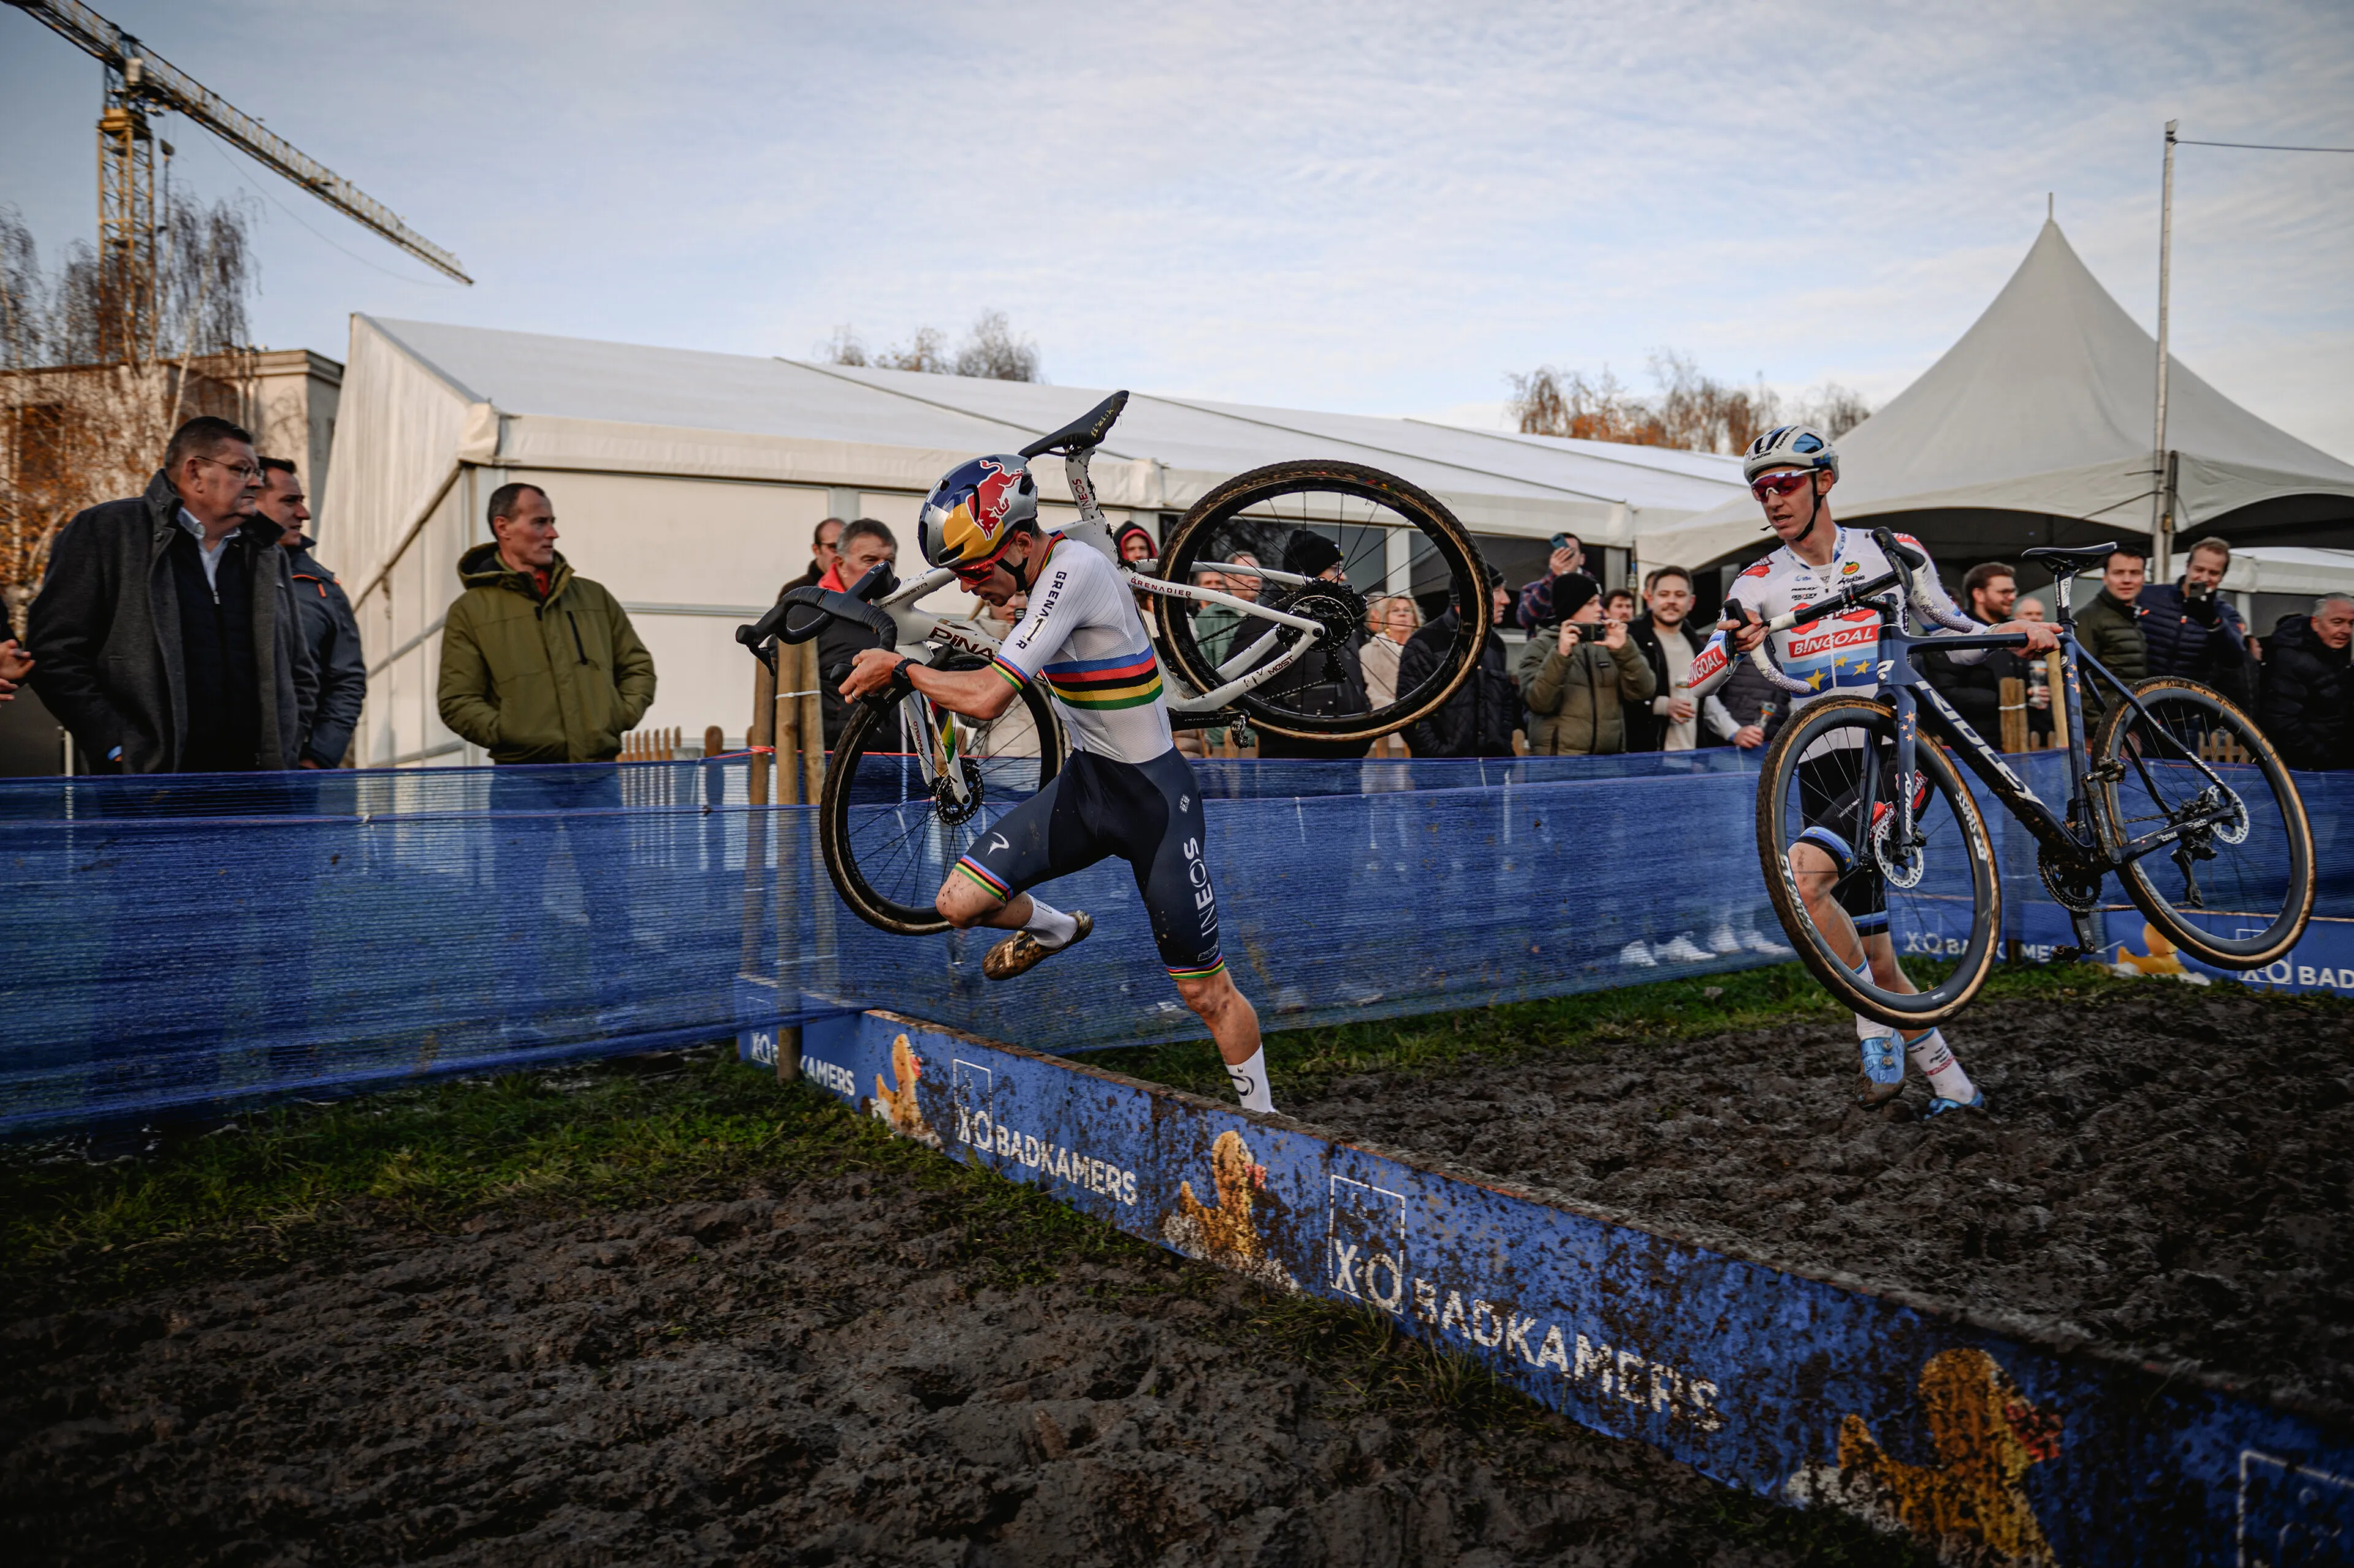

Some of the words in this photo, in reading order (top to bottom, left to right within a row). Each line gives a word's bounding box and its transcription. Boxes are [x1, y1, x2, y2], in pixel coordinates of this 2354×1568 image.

[1072, 478, 1092, 512] INEOS
[1016, 571, 1067, 650] GRENAR
[1130, 577, 1192, 598] GRENADIER
[1915, 680, 2046, 807] RIDLEY
[1183, 837, 1218, 938] INEOS
[996, 1124, 1138, 1206] BADKAMERS
[1414, 1277, 1721, 1432] BADKAMERS
